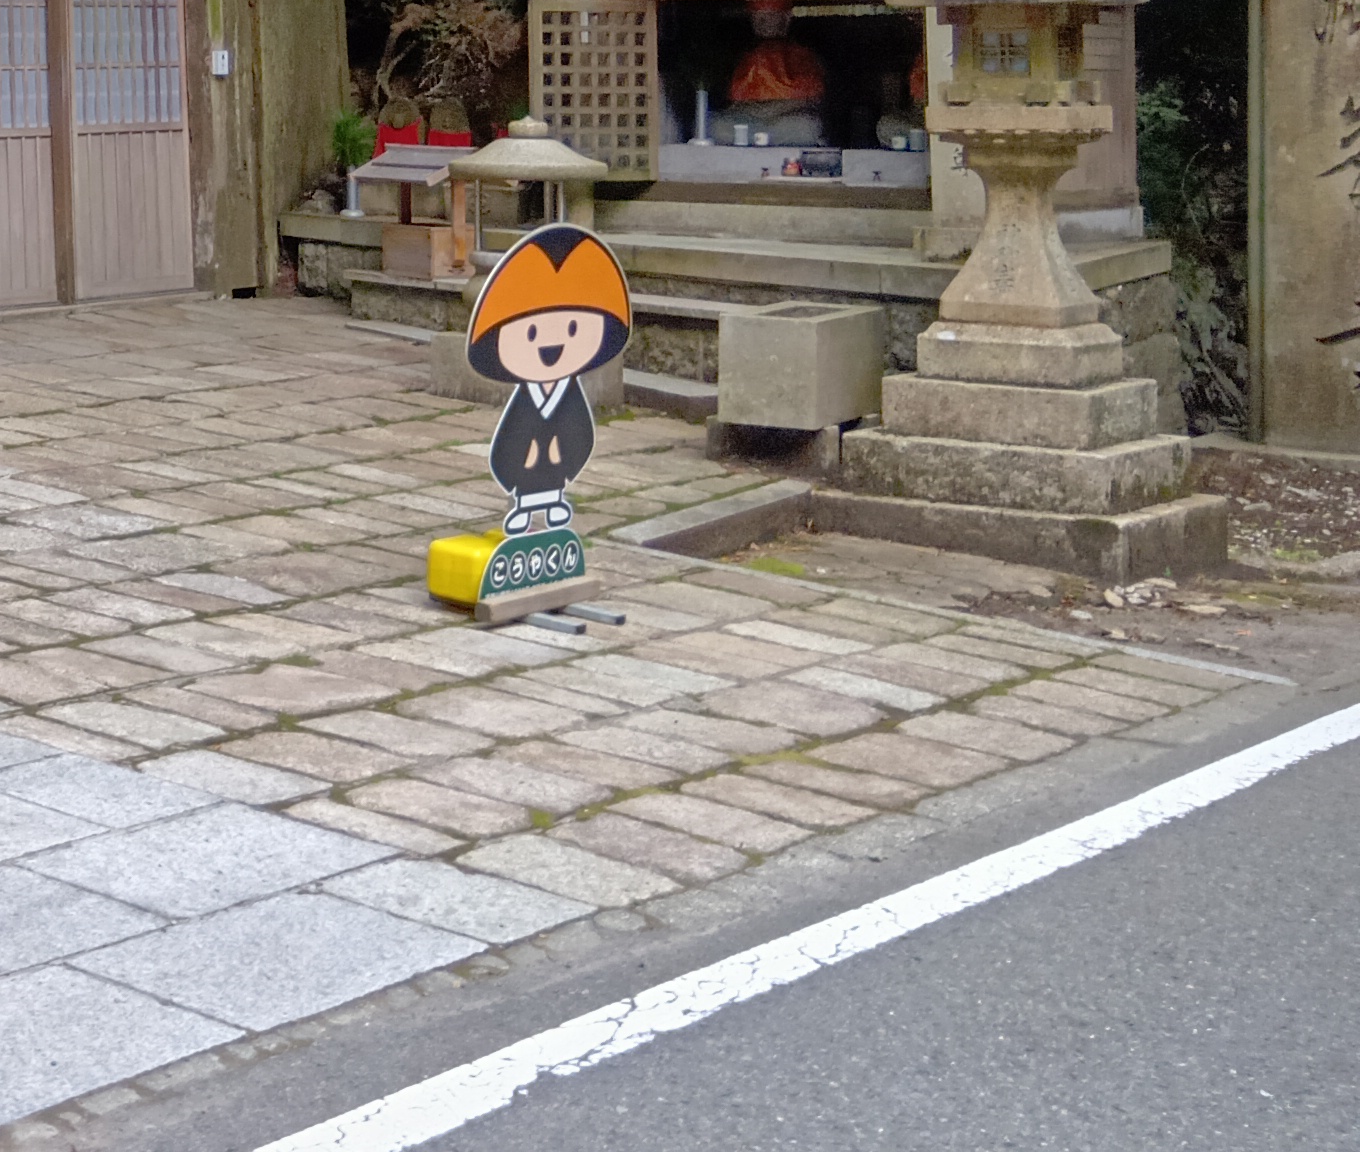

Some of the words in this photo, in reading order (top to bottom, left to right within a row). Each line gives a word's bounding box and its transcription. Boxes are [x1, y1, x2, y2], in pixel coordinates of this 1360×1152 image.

[493, 546, 577, 582] こうやくん
